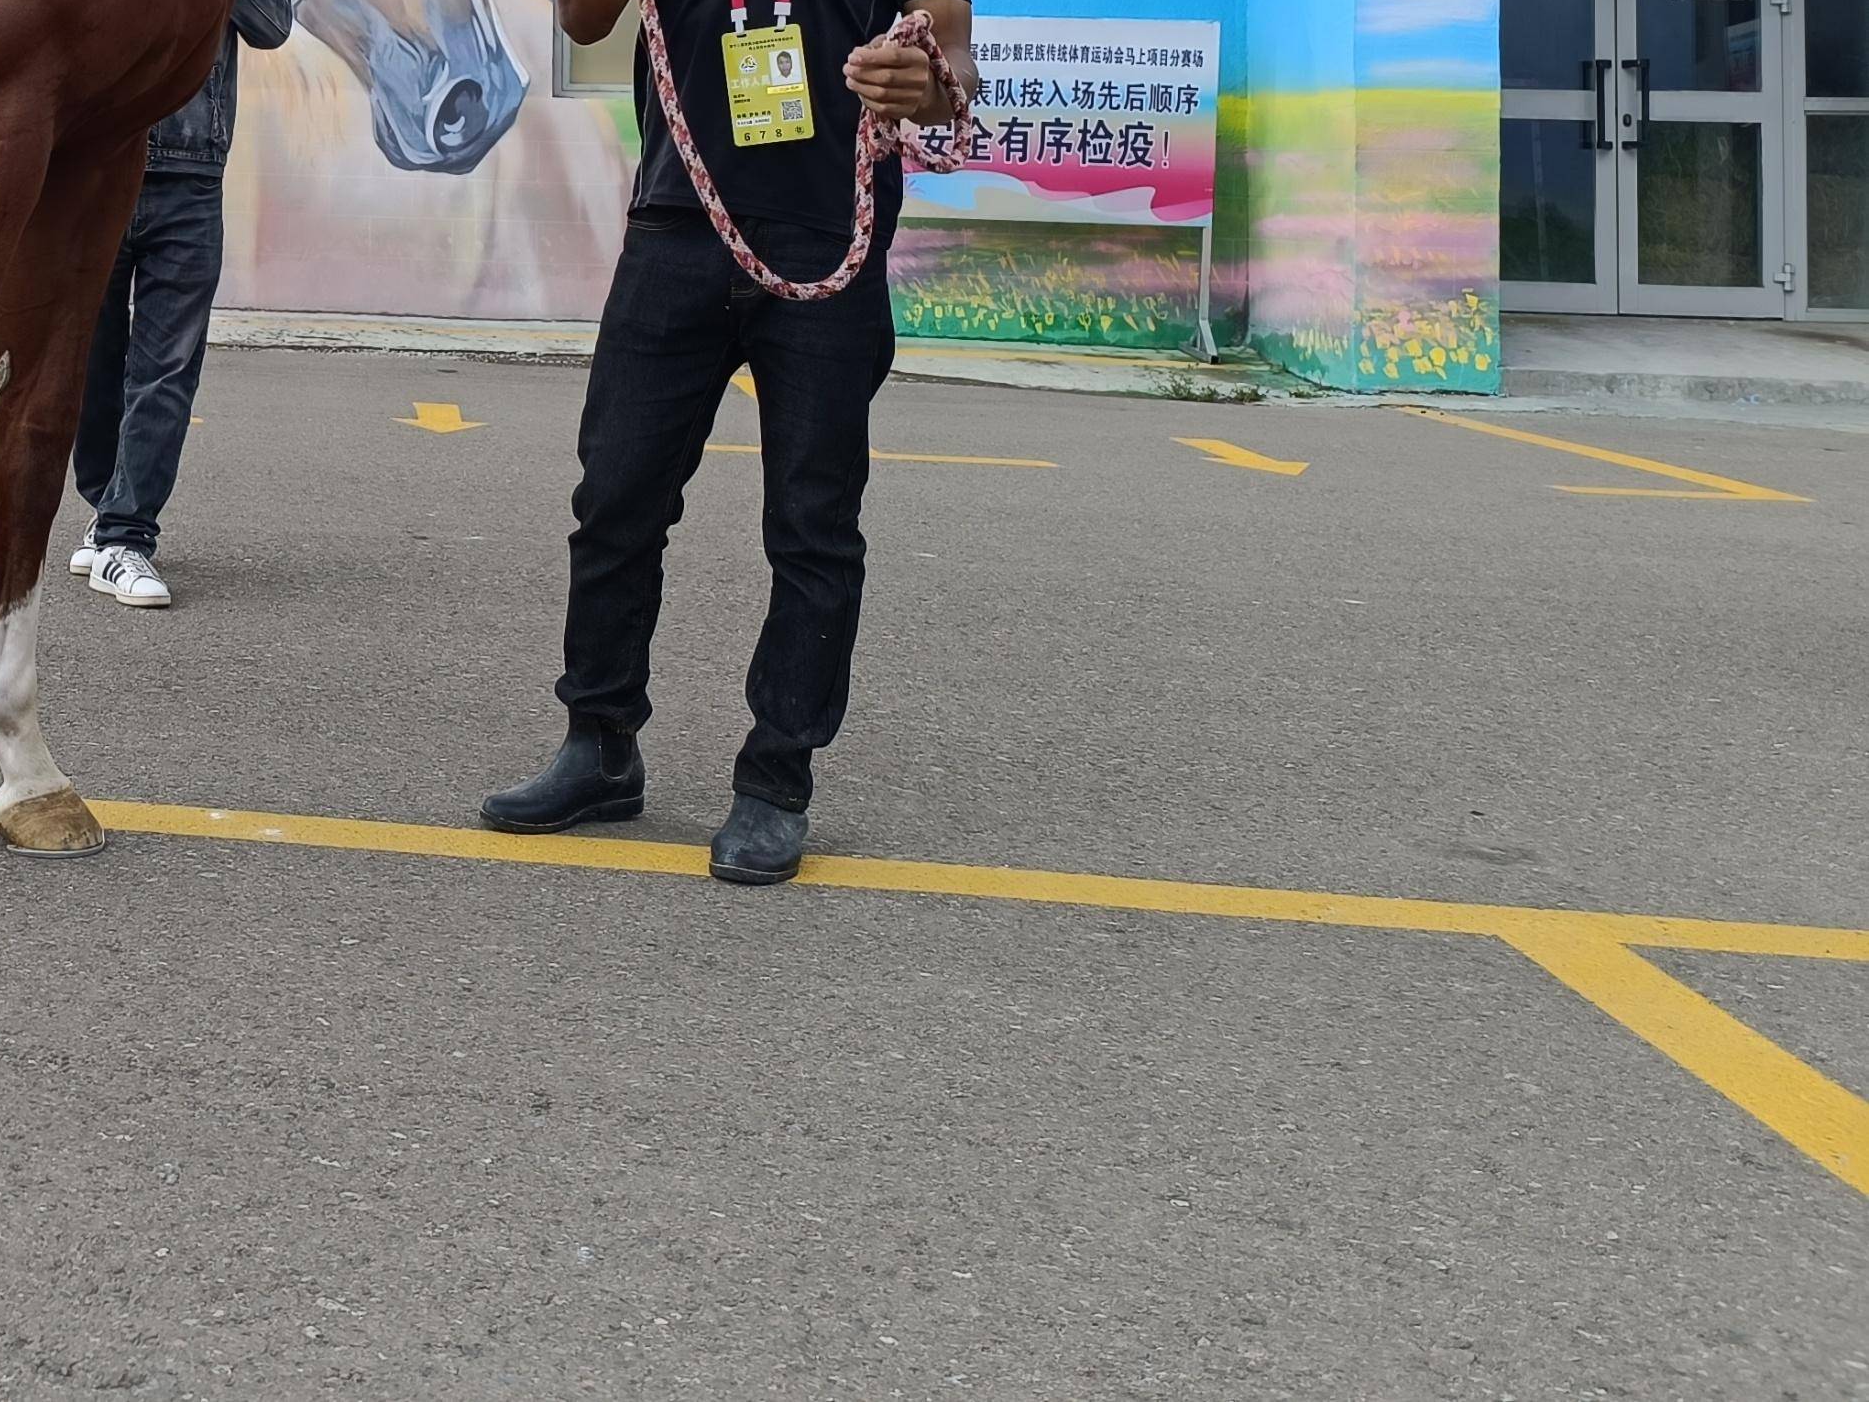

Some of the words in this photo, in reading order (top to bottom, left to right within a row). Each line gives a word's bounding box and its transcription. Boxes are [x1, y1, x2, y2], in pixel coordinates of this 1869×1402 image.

[974, 77, 1199, 115] 表队按入场先后顺序
[744, 133, 751, 142] 6
[759, 130, 766, 139] 7
[775, 129, 783, 138] 8
